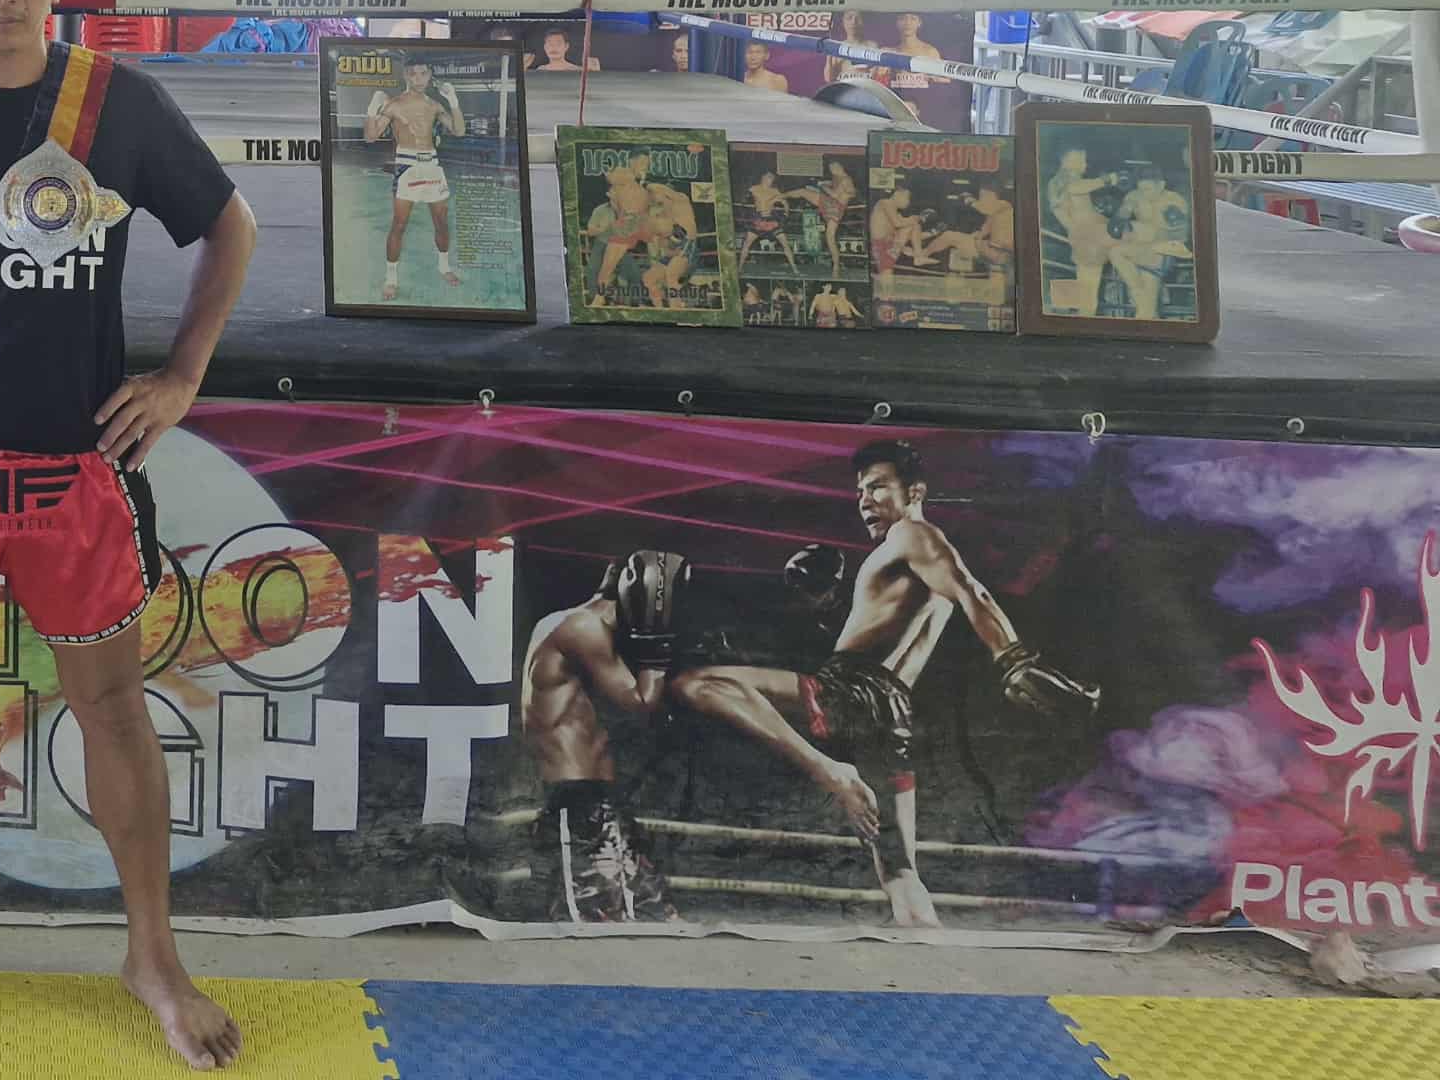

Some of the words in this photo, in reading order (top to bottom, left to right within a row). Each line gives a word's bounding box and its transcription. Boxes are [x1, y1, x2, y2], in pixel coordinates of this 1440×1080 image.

[783, 13, 832, 30] 2025
[1270, 116, 1291, 131] THE
[1292, 118, 1329, 138] MOON
[1330, 124, 1368, 145] FIGHT
[242, 139, 282, 161] THE
[288, 139, 321, 161] MO
[1239, 152, 1304, 175] FIGHT
[1231, 862, 1440, 928] Plant
